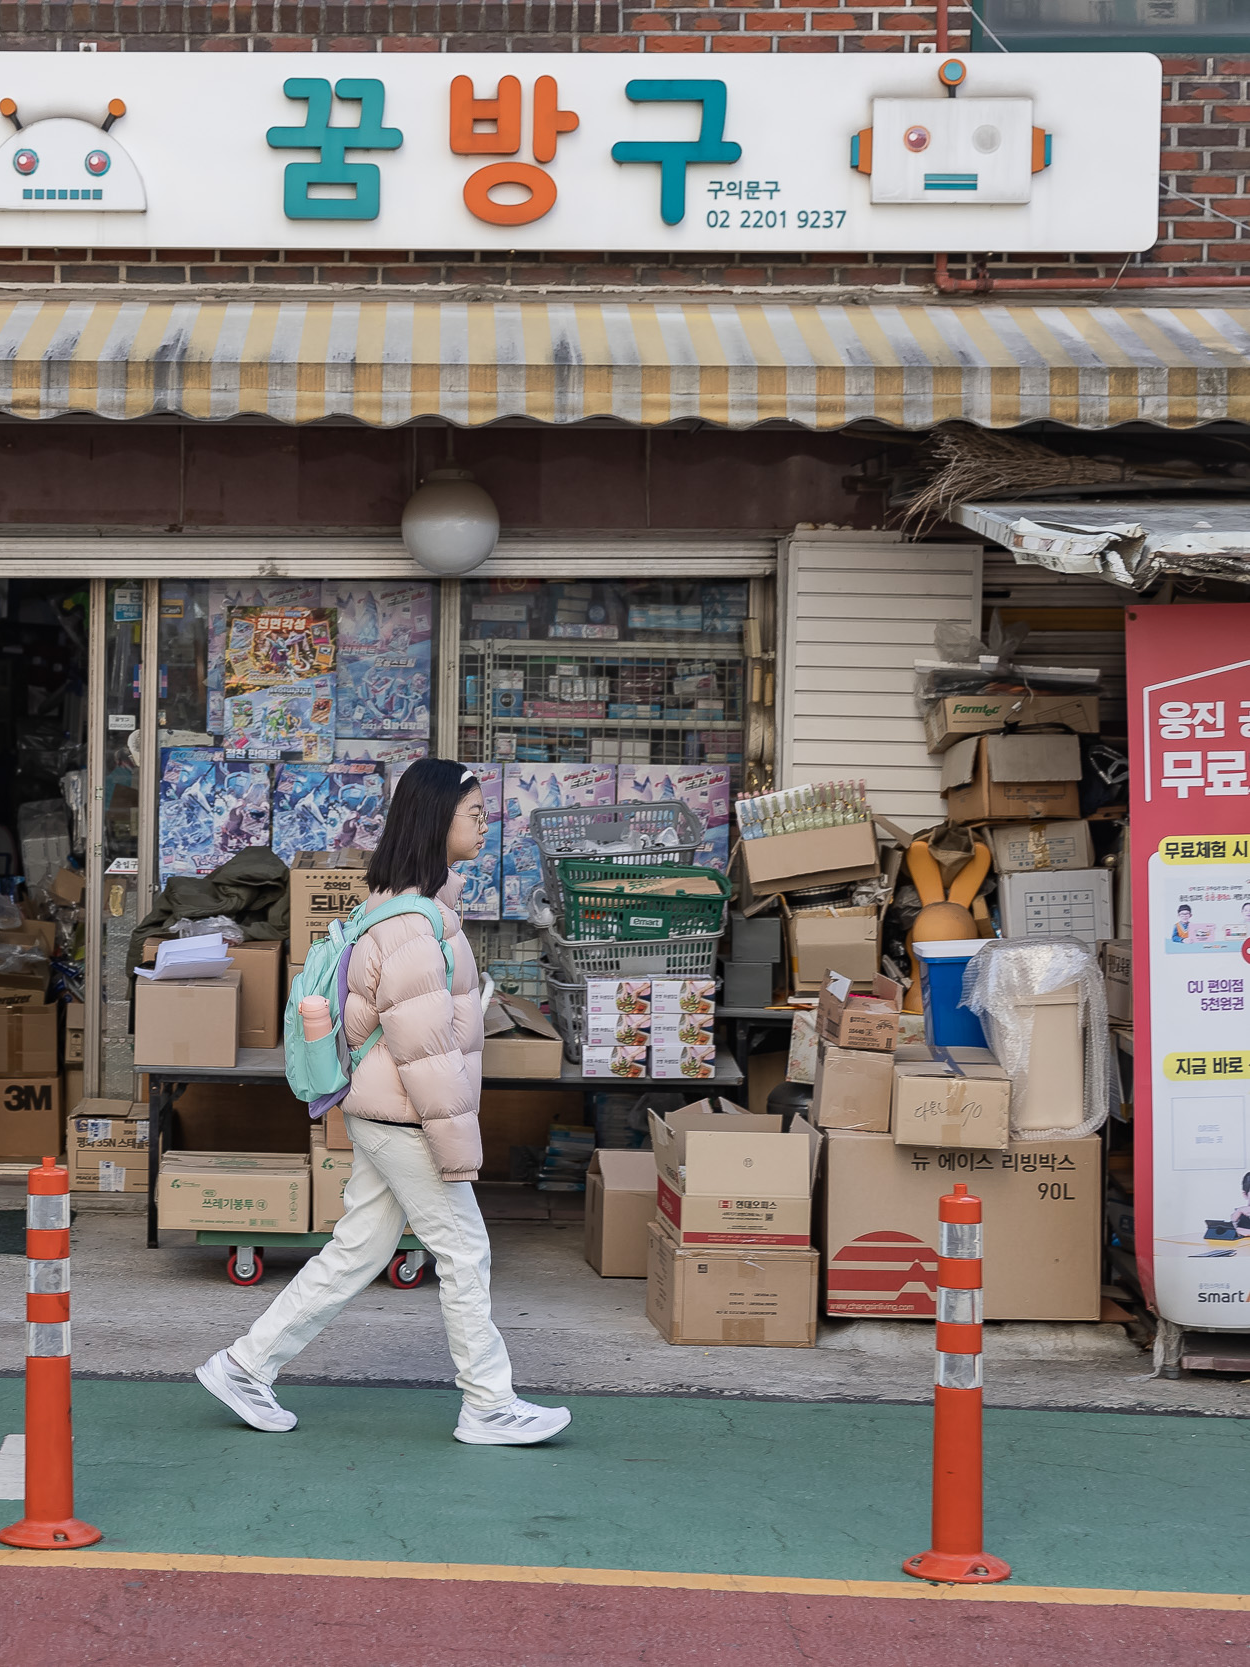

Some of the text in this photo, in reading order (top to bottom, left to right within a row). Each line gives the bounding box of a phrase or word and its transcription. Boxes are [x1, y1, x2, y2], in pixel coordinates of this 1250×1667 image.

[705, 179, 782, 200] 구의문구
[705, 211, 847, 229] 02 2201 9237
[952, 703, 1002, 717] Formtec
[1157, 701, 1226, 740] 웅진
[1161, 751, 1250, 799] 무료
[1164, 840, 1227, 860] 무료체험
[114, 860, 139, 869] 출입구
[323, 881, 351, 891] 추억의
[633, 917, 661, 928] emart
[1186, 979, 1244, 994] CU 편의점
[1200, 996, 1245, 1011] 5천원권
[1175, 1056, 1243, 1075] 지금 바로
[3, 1084, 53, 1112] 3M
[911, 1151, 1077, 1173] 뉴 에이스 리빙박스
[1037, 1182, 1076, 1201] 90L
[201, 1198, 254, 1211] 쓰레기봉투
[736, 1200, 778, 1209] 현대오피스
[1198, 1290, 1250, 1303] smart
